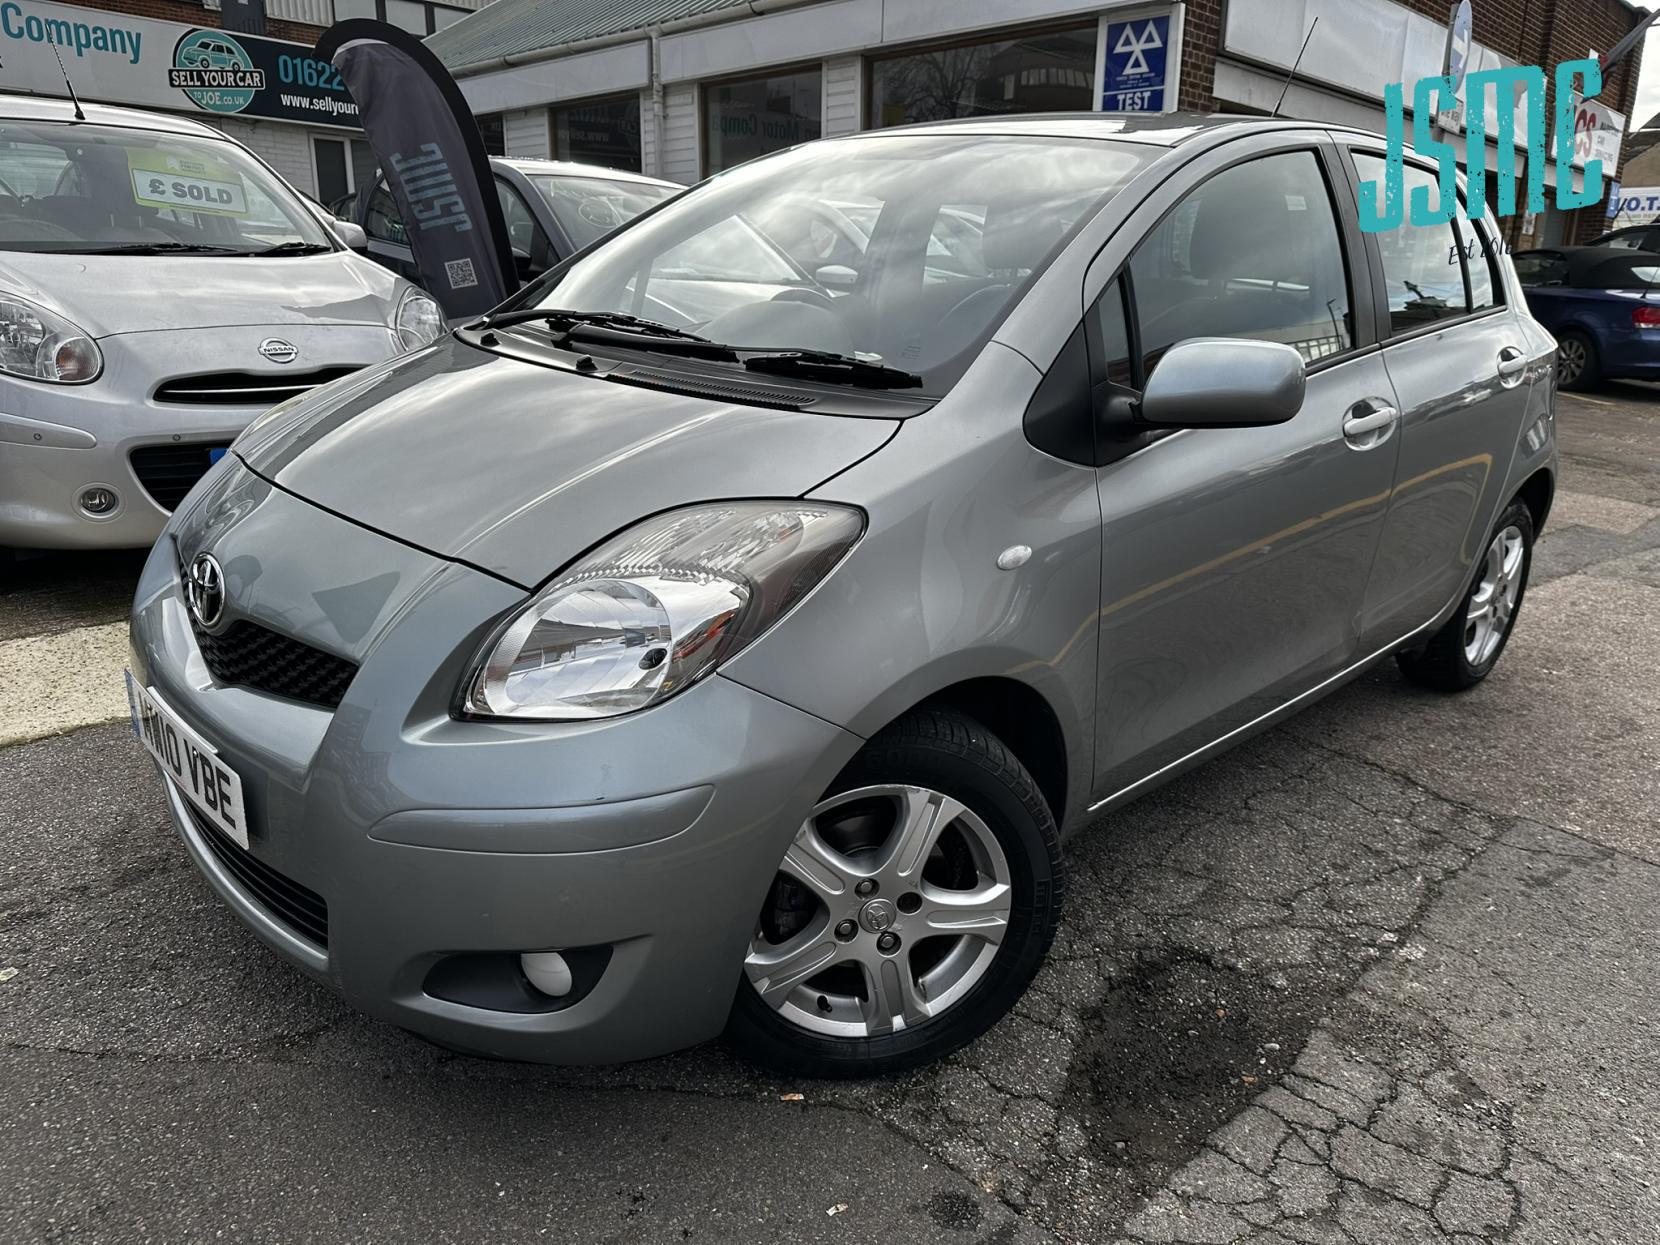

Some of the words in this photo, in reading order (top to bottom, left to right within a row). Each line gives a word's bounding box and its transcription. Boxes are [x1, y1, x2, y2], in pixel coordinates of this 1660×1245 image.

[1, 2, 142, 64] Company
[172, 71, 200, 86] SELL
[201, 71, 235, 86] YOUR
[236, 72, 261, 87] CAR
[278, 55, 345, 90] 01622
[1117, 91, 1151, 111] TEST
[149, 179, 166, 195] £
[171, 182, 232, 204] SOLD
[389, 142, 473, 232] JSMC
[184, 738, 237, 830] VBE
